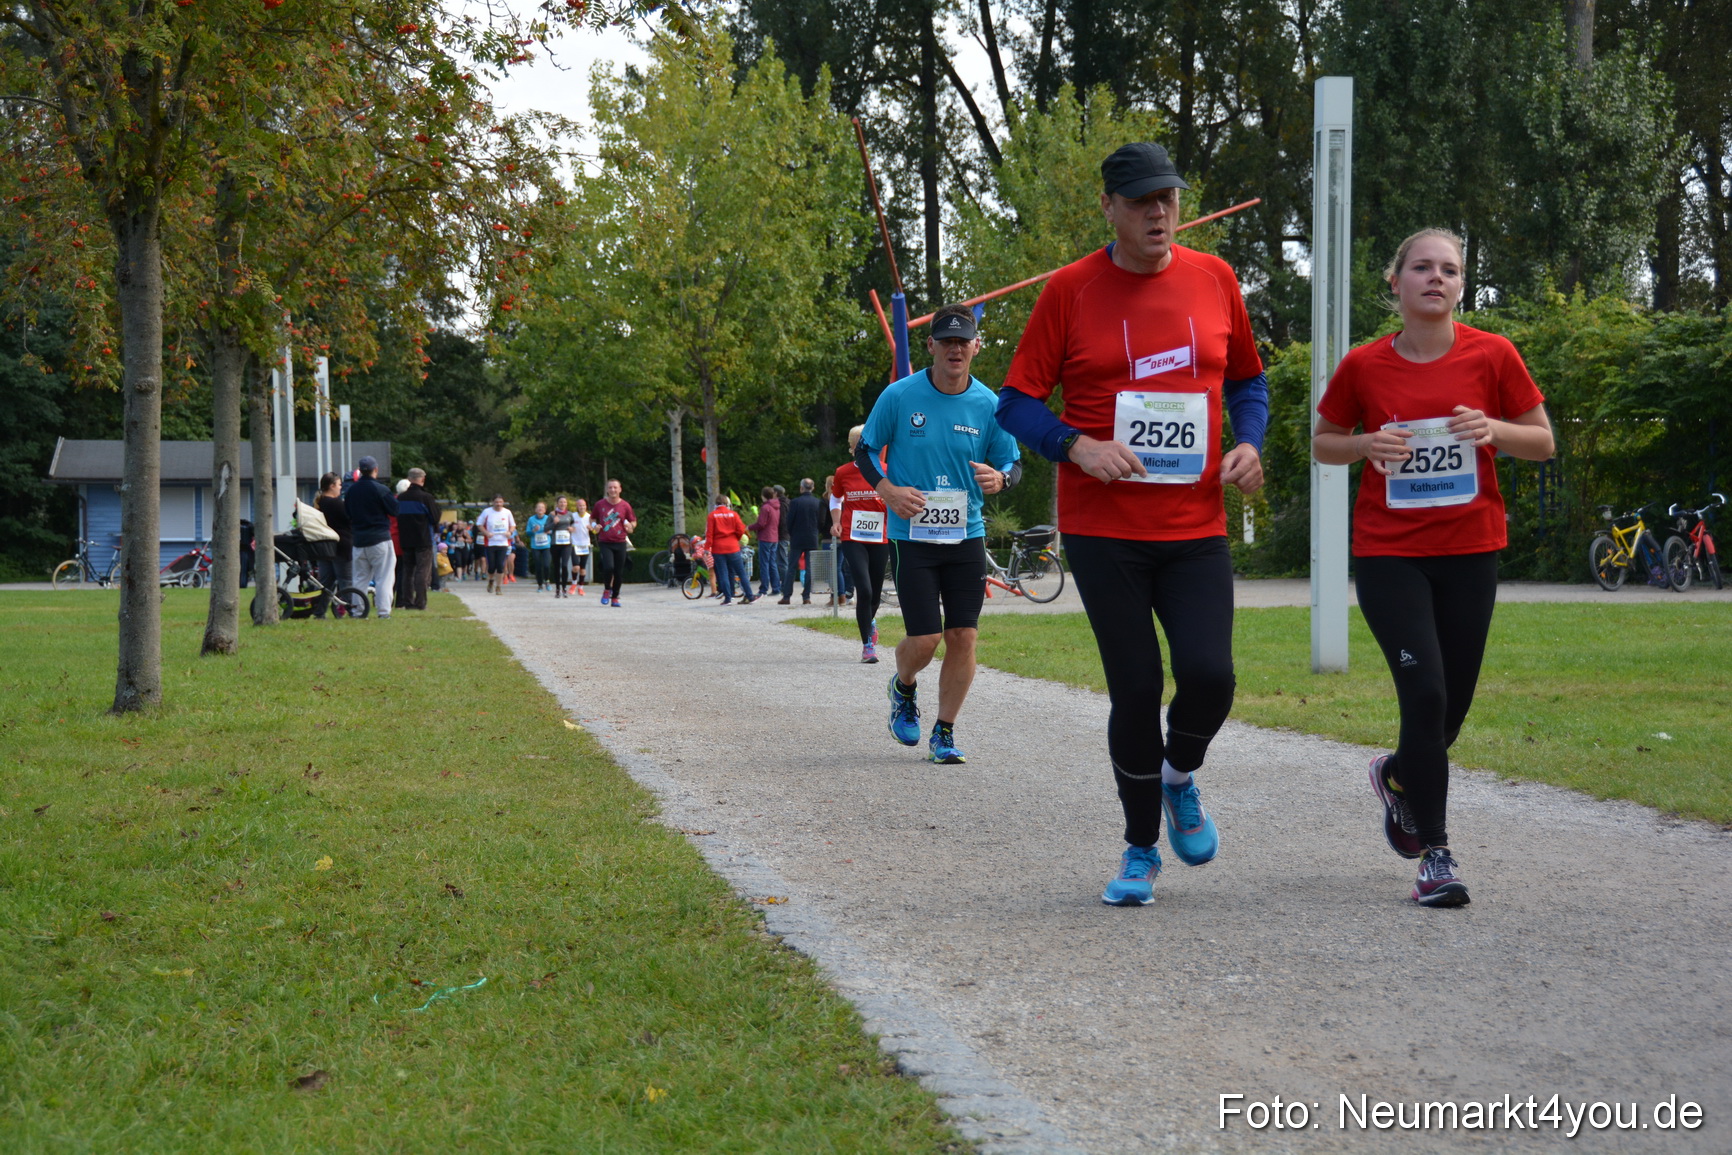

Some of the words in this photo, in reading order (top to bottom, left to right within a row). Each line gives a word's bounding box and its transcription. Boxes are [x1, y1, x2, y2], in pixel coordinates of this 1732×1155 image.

[1150, 355, 1175, 369] DEHN
[954, 424, 979, 435] BOCK
[1129, 420, 1195, 449] 2526
[1143, 457, 1180, 468] Michael
[1400, 444, 1462, 474] 2525
[936, 475, 951, 486] 18.
[1410, 481, 1455, 493] Katharina
[920, 507, 960, 524] 2333
[856, 520, 879, 531] 2507
